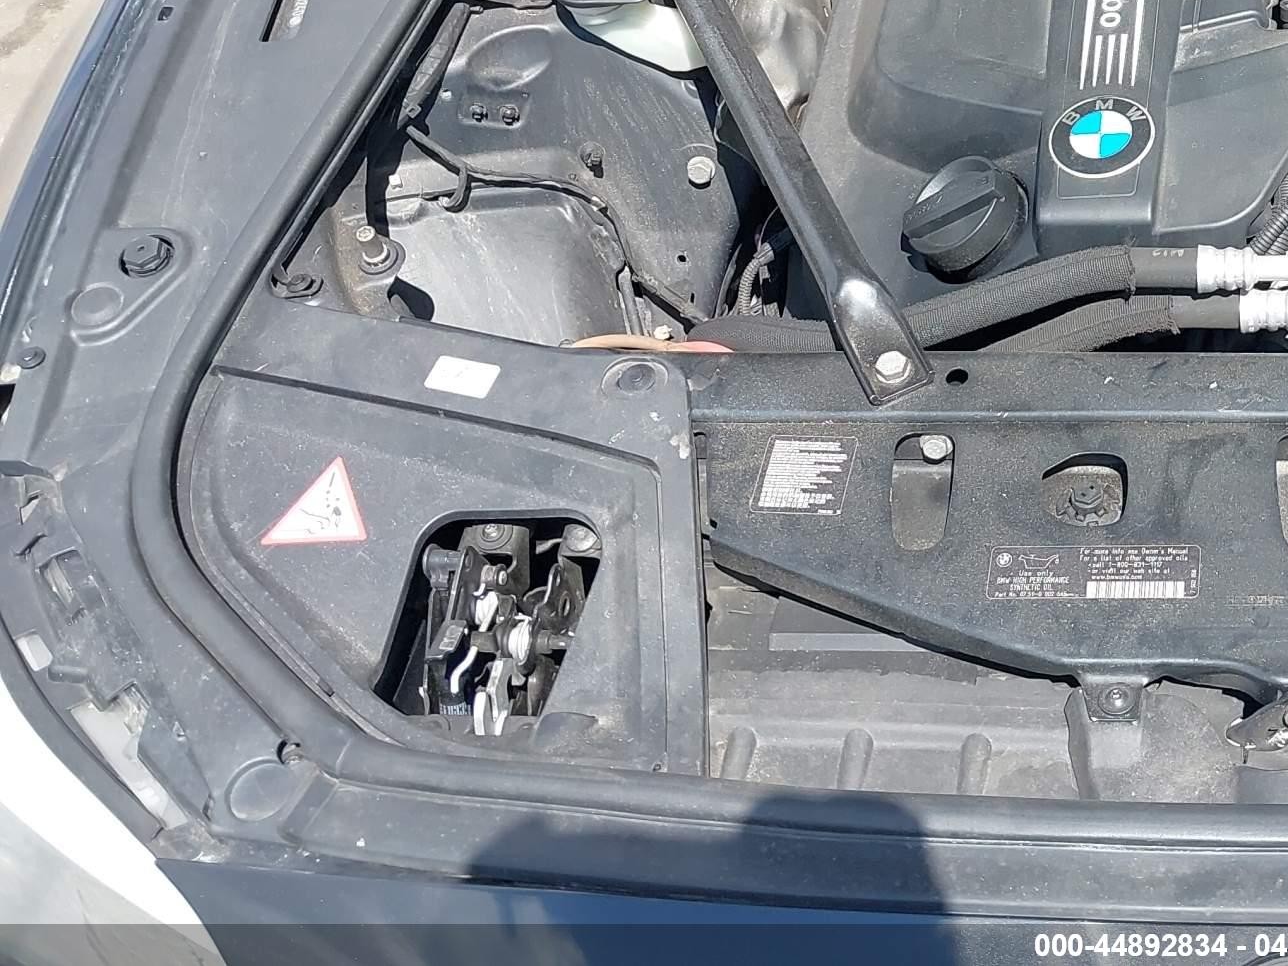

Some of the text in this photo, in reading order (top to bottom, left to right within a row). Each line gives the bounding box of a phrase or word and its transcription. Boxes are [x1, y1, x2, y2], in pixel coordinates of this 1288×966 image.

[1061, 98, 1147, 126] BMW
[1036, 570, 1054, 579] only
[1028, 576, 1070, 584] PERFORMANCE
